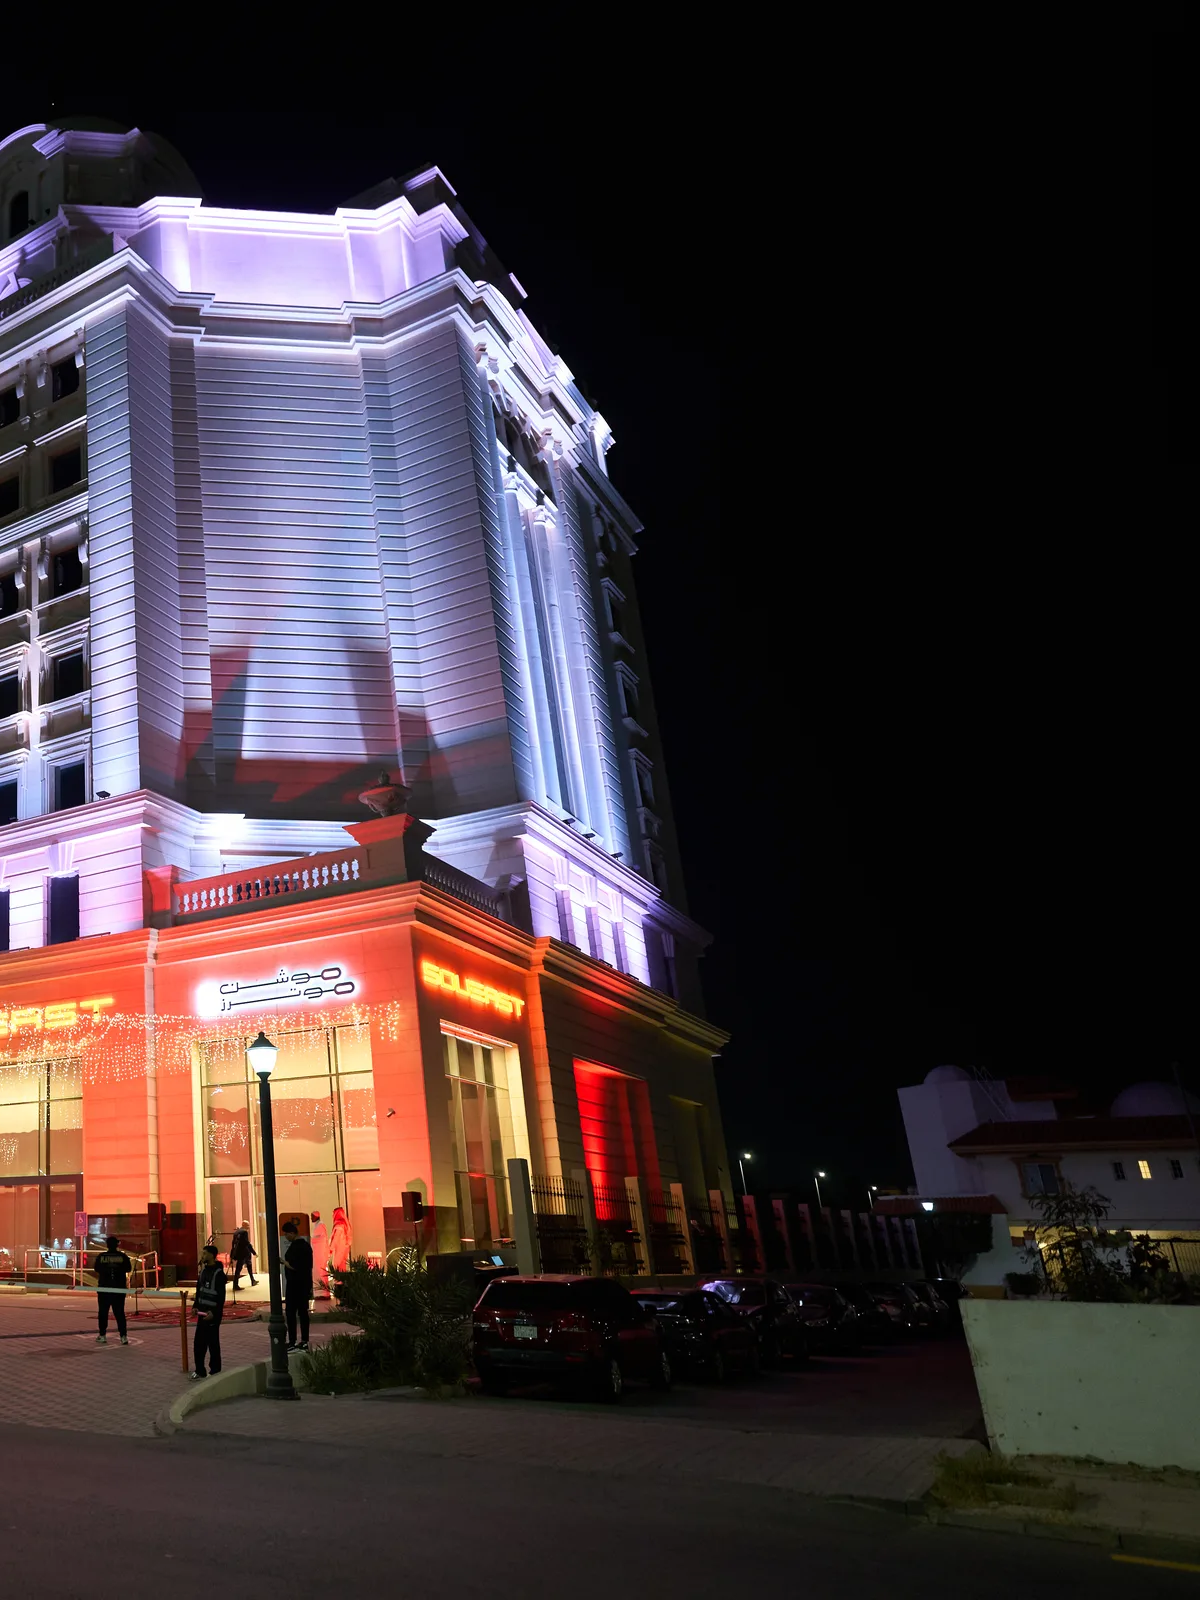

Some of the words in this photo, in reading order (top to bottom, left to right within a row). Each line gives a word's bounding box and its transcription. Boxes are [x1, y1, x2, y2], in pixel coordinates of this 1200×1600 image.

[219, 968, 341, 995] موشن
[221, 981, 355, 1011] موترز
[422, 961, 525, 1018] SOUEAST
